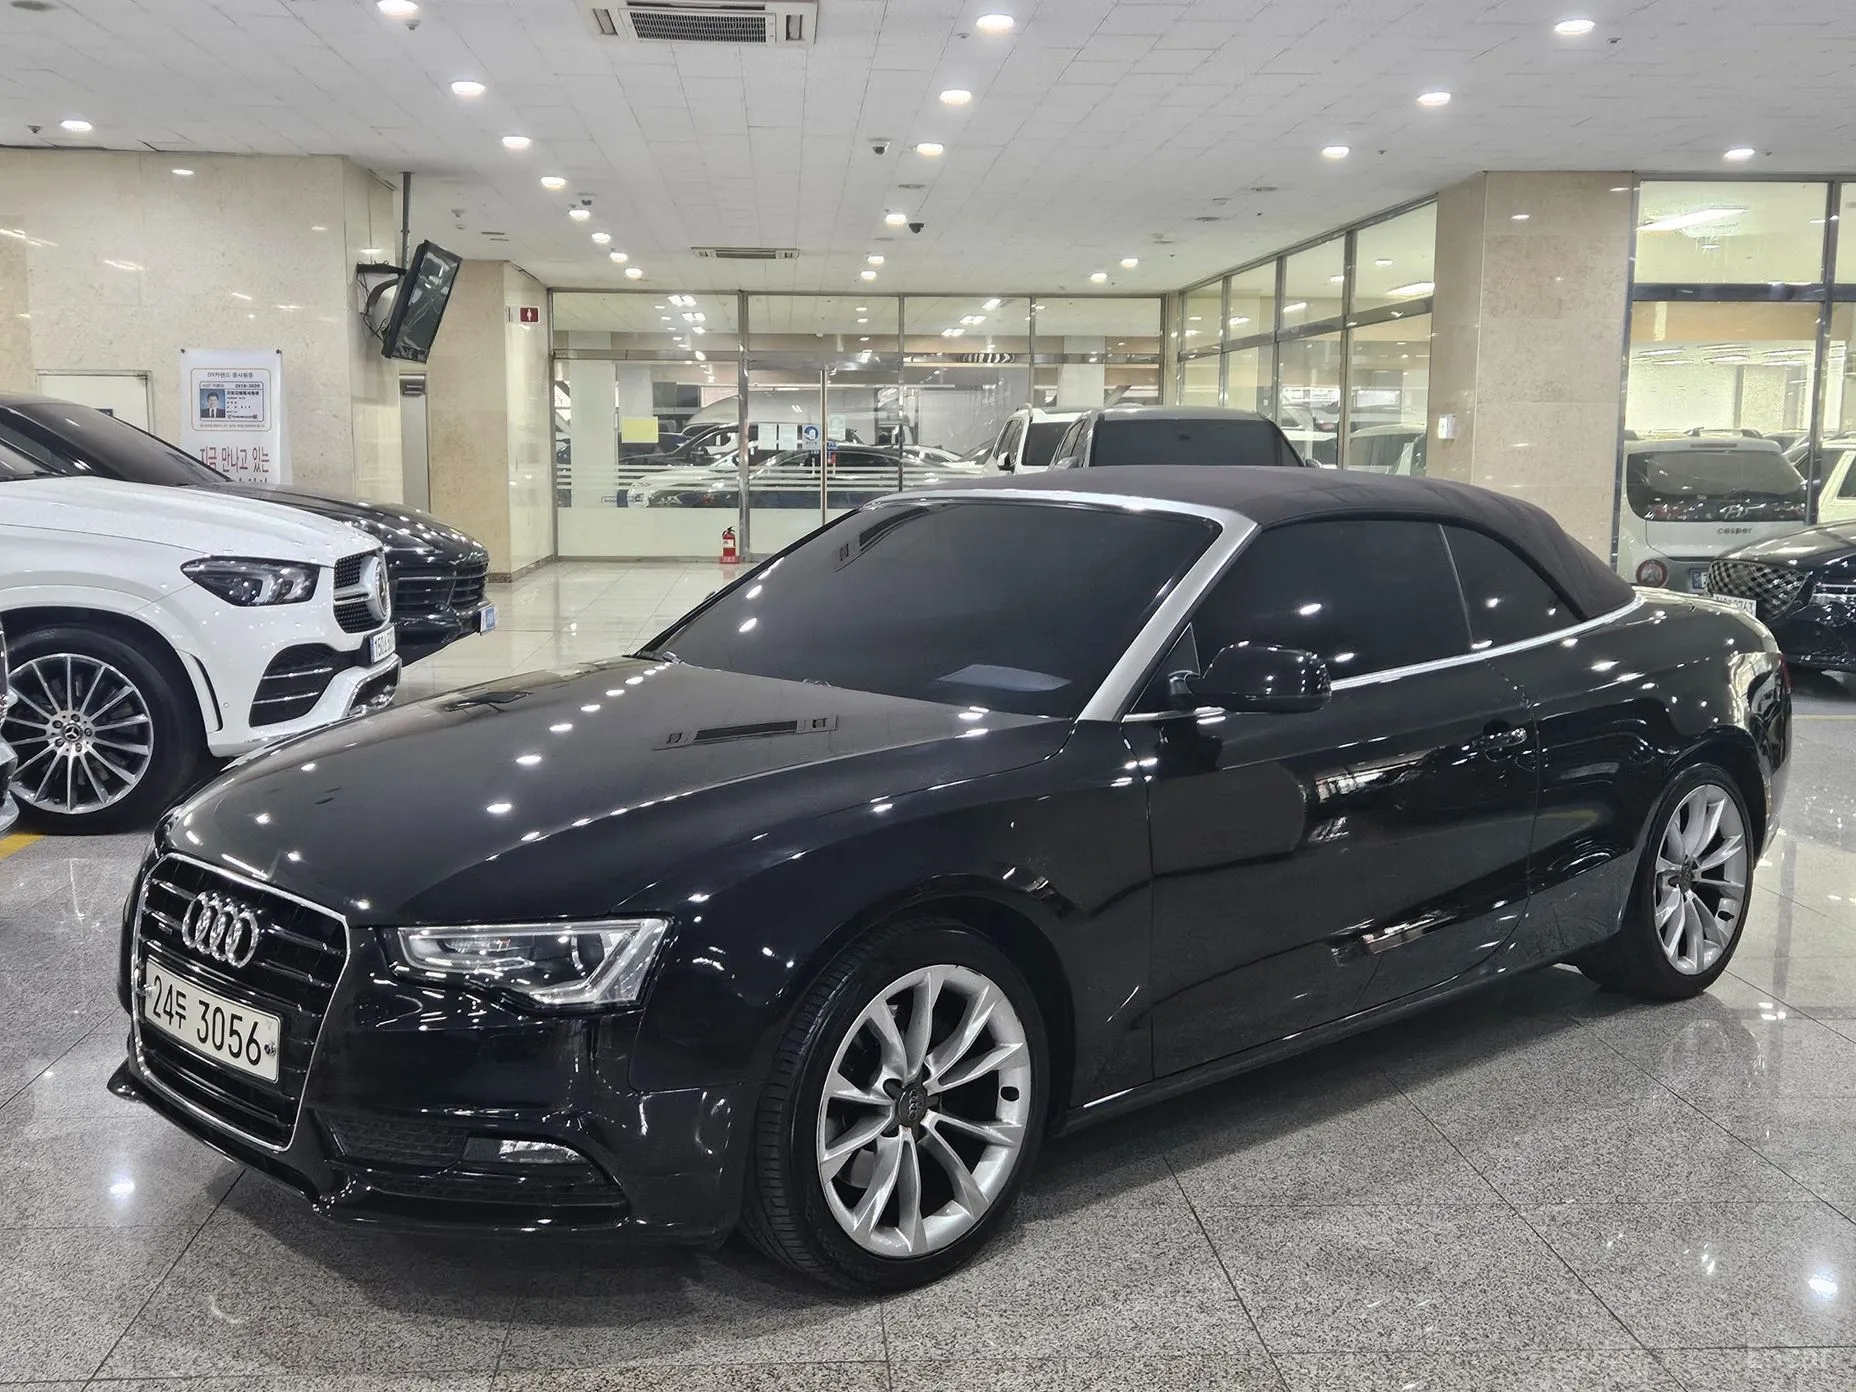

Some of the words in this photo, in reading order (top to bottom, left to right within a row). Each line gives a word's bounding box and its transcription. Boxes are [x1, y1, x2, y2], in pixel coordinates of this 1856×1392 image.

[200, 446, 217, 470] 지금
[222, 446, 248, 472] 만나고
[252, 446, 269, 472] 있는
[153, 975, 187, 1029] 24두
[197, 1000, 261, 1065] 3056
